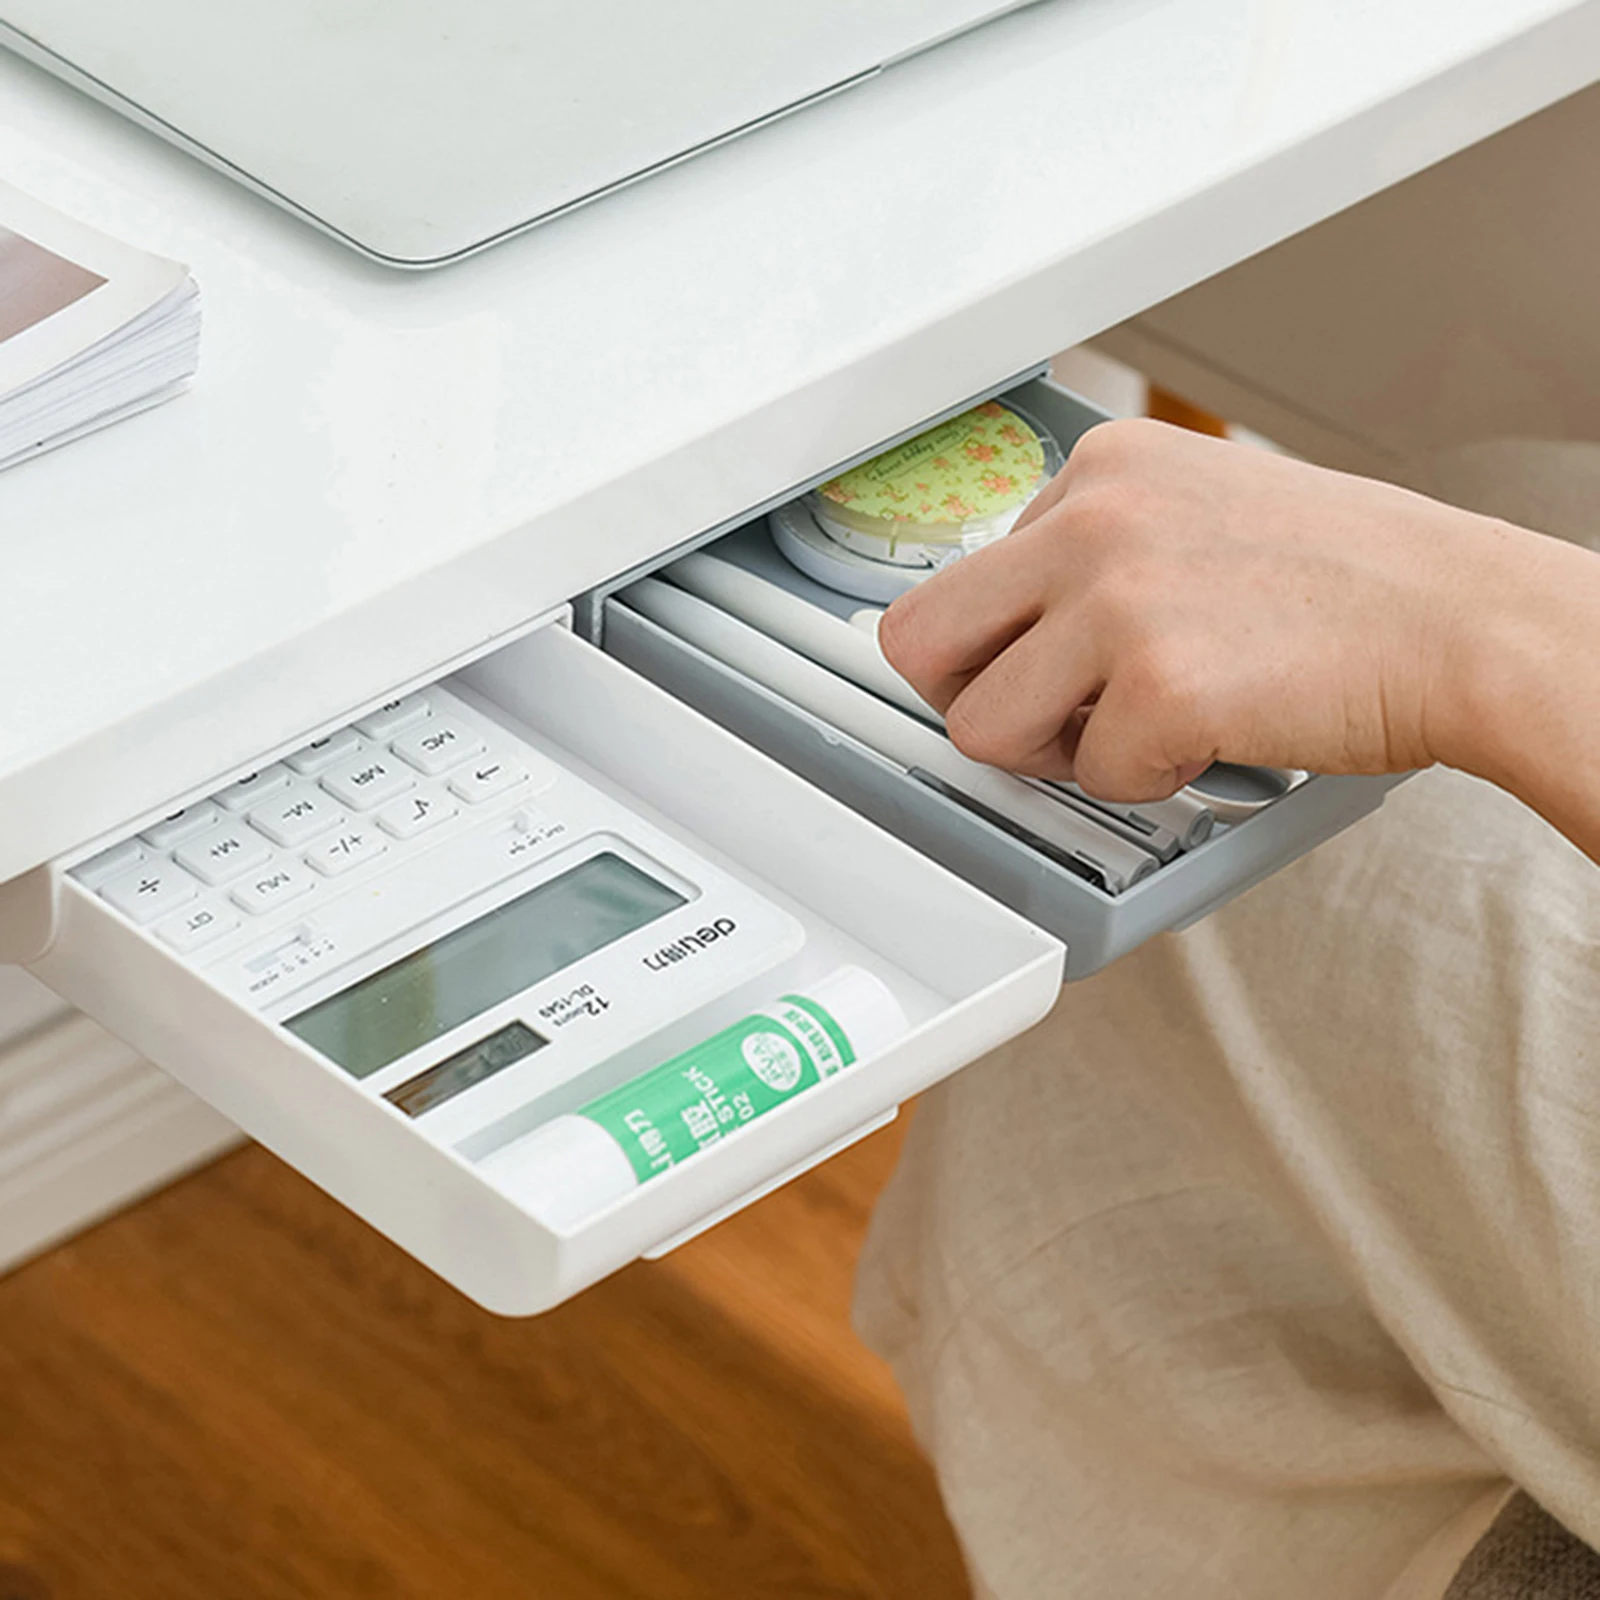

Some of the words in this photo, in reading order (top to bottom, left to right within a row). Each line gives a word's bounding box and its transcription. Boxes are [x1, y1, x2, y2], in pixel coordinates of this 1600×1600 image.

[421, 731, 457, 750] MC
[586, 996, 610, 1017] 12
[682, 1066, 735, 1124] STICK
